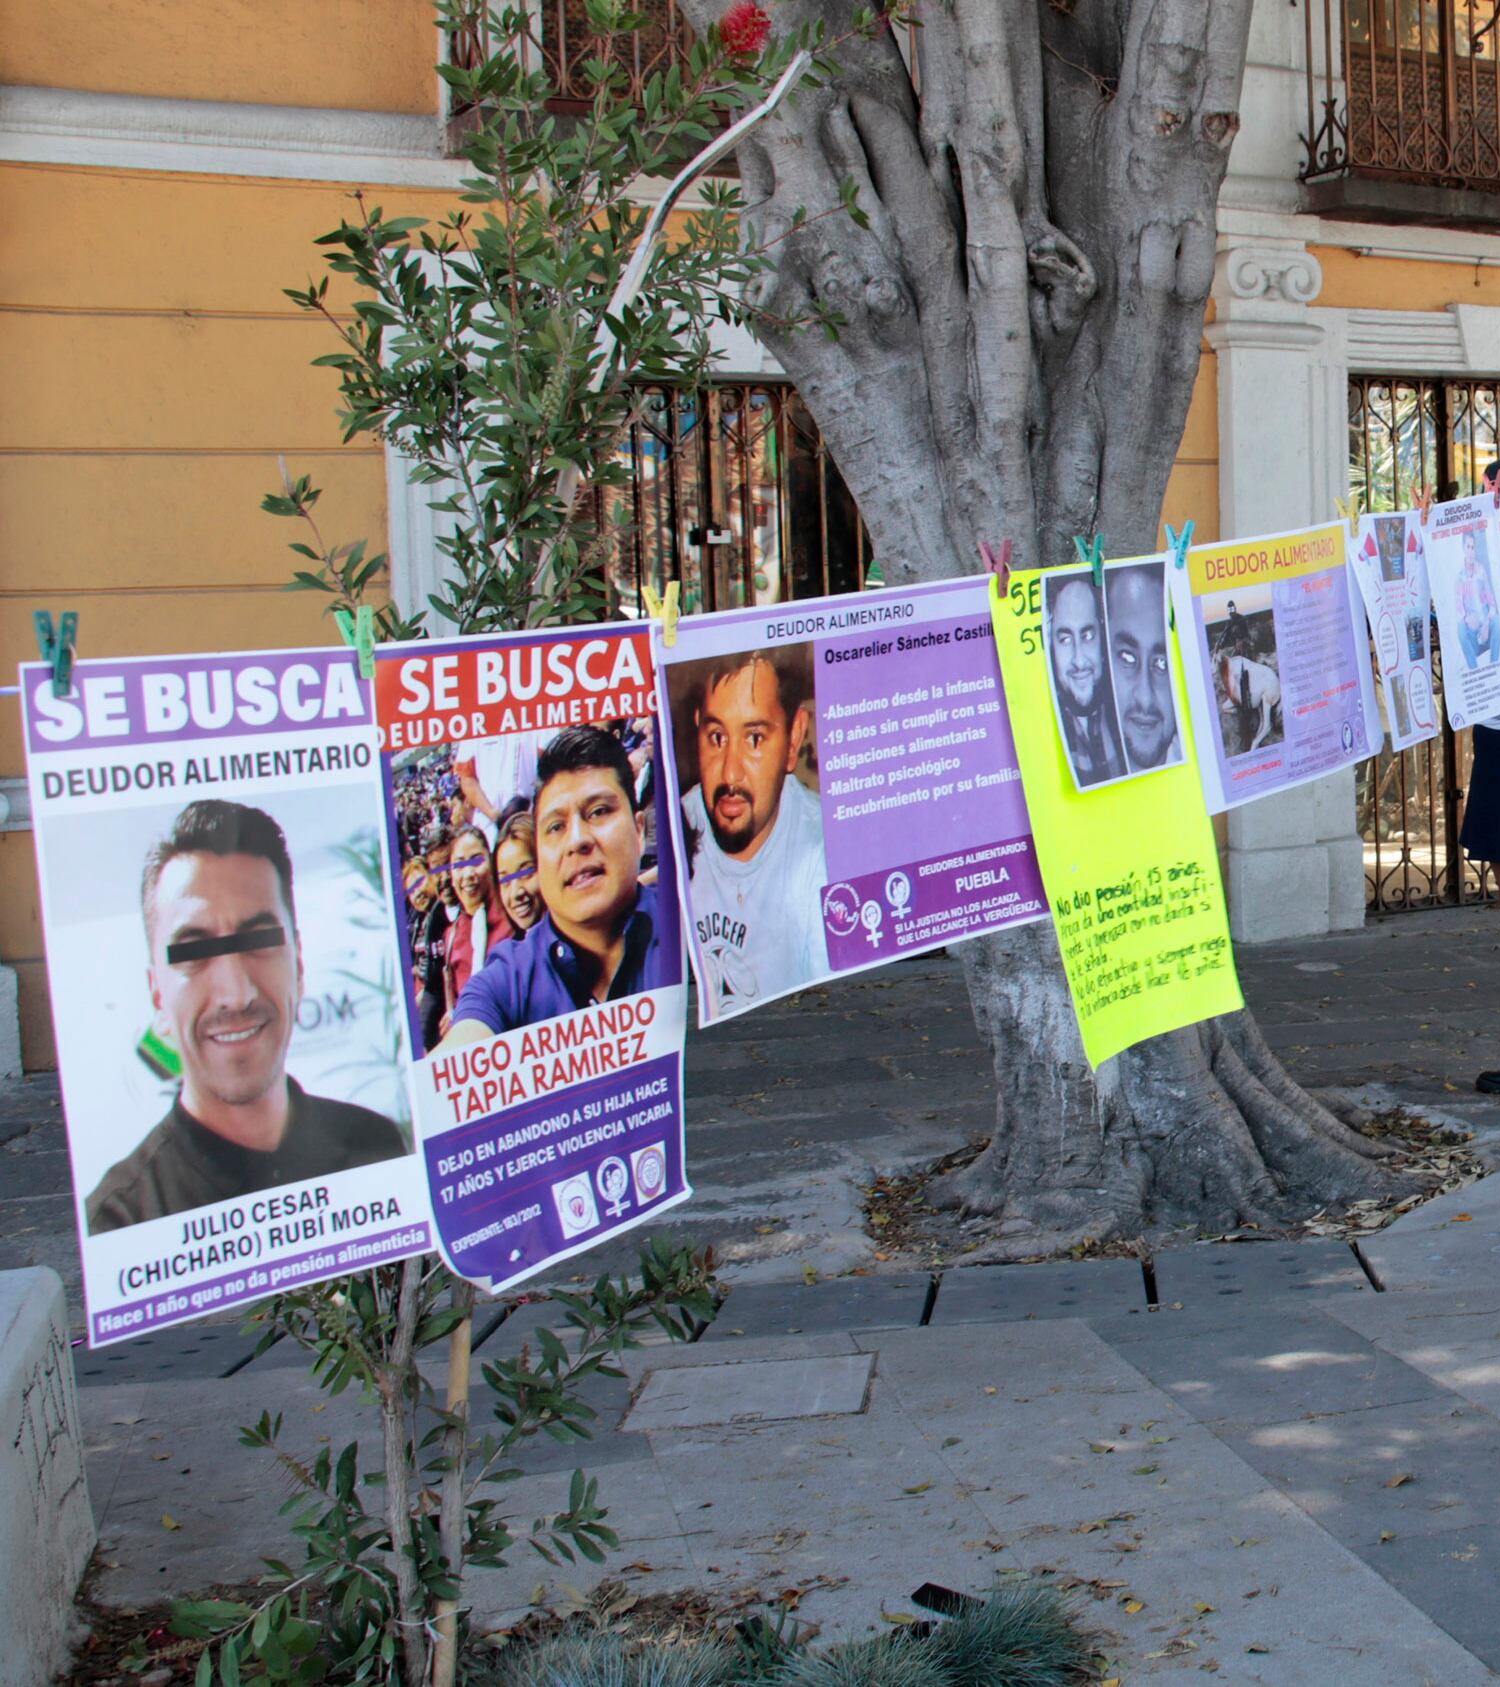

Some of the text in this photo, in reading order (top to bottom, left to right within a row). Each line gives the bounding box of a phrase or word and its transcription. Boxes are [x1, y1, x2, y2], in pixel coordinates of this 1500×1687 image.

[1436, 510, 1482, 527] ALIMENTARIO
[1444, 503, 1472, 517] DEUDOR
[1206, 537, 1335, 581] DEUDOR ALIMENTARIO
[766, 603, 914, 639] DEUDOR ALIMENTARIO
[825, 622, 994, 665] Oscarelier Sánchez Castill
[399, 638, 645, 715] SE BUSCA
[823, 675, 994, 721] -Abandono desde la infancia
[34, 663, 364, 742] SE BUSCA
[846, 723, 877, 741] años
[880, 717, 898, 735] sin
[902, 709, 949, 734] cumplir
[951, 707, 974, 721] con
[977, 700, 1000, 716] sus
[43, 743, 371, 799] DEUDOR ALIMENTARIO
[825, 727, 987, 773] obligaciones alimentarias
[827, 756, 960, 797] -Maltrato psicológico
[832, 768, 1021, 821] -Encubrimiento por su familia
[918, 841, 1027, 877] DEUDORES ALIMENTARIOS
[955, 868, 1010, 893] PUEBLA
[895, 892, 1021, 934] SI LA JUSTICIA NO LOS ALCANZA
[897, 899, 1041, 946] QUE LOS ALCANCE LA VERGÜENZA
[1057, 896, 1070, 918] No
[1074, 889, 1091, 910] dio
[432, 996, 656, 1093] HUGO ARMANDO
[447, 1032, 648, 1123] TAPIA RAMIREZ
[438, 1077, 668, 1177] DEJO EN ABANDONO A SU HIJA HACE
[440, 1101, 673, 1205] 17 AÑOS Y EJERCE VIOLENCIA VICARIA
[182, 1186, 331, 1244] JULIO CESAR
[118, 1198, 401, 1297] (CHICHARO) RUBÍ MORA
[99, 1227, 425, 1333] Hace 1 año que no da pensión alimenticia
